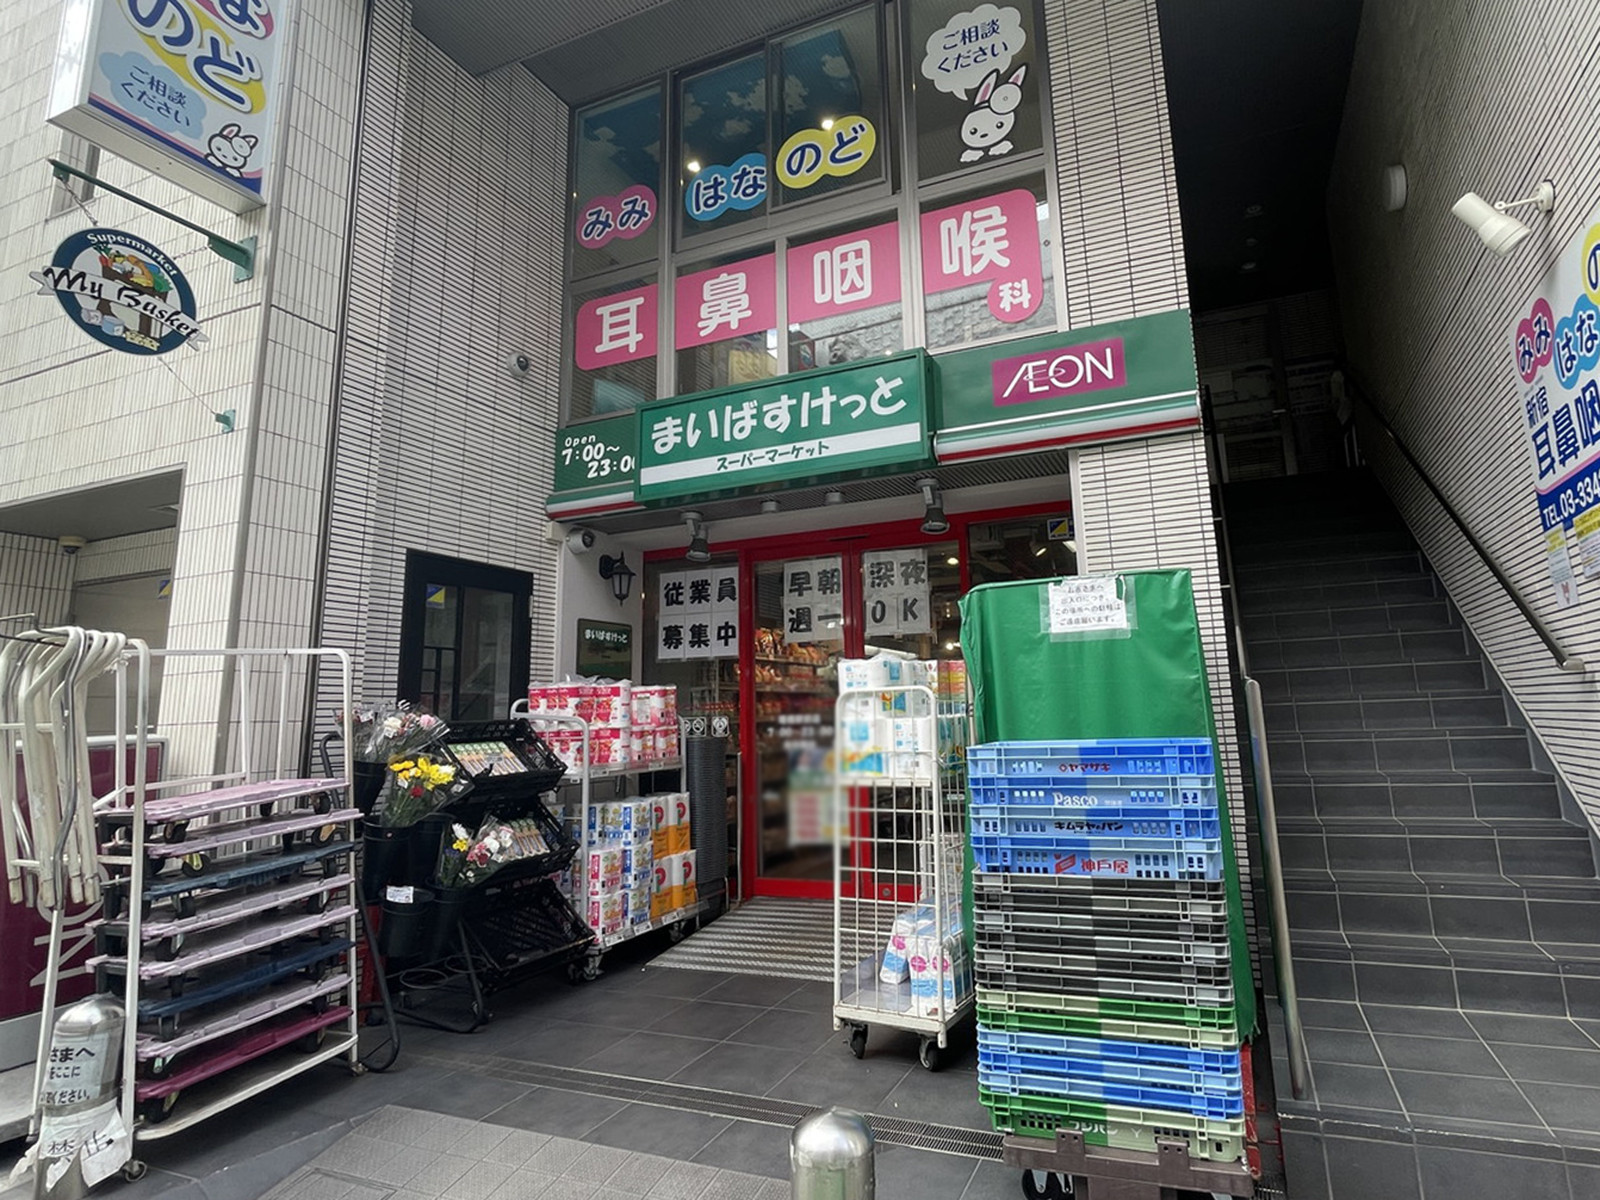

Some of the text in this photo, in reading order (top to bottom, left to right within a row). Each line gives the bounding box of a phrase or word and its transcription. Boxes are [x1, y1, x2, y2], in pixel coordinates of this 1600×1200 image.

[943, 19, 1000, 50] ご相談
[938, 41, 1008, 73] ください
[130, 65, 187, 109] ご相談
[121, 82, 190, 127] ください
[582, 122, 866, 241] みみ はな のど
[86, 232, 178, 277] Supermarket
[43, 267, 199, 338] My Basket
[1518, 312, 1599, 379] みみ はな
[651, 375, 907, 455] まいばすけっと
[1525, 385, 1550, 429] 新宿
[564, 434, 597, 448] Open
[716, 440, 830, 472] スーパーマーケット
[587, 454, 636, 479] 23:0
[788, 567, 842, 598] 早朝
[869, 558, 927, 589] 深夜
[663, 577, 738, 607] 従業員
[788, 606, 842, 634] 週一
[870, 597, 920, 624] OK
[662, 620, 738, 650] 募集中
[1052, 792, 1098, 806] Pasco
[1081, 858, 1130, 873] 神戸屋
